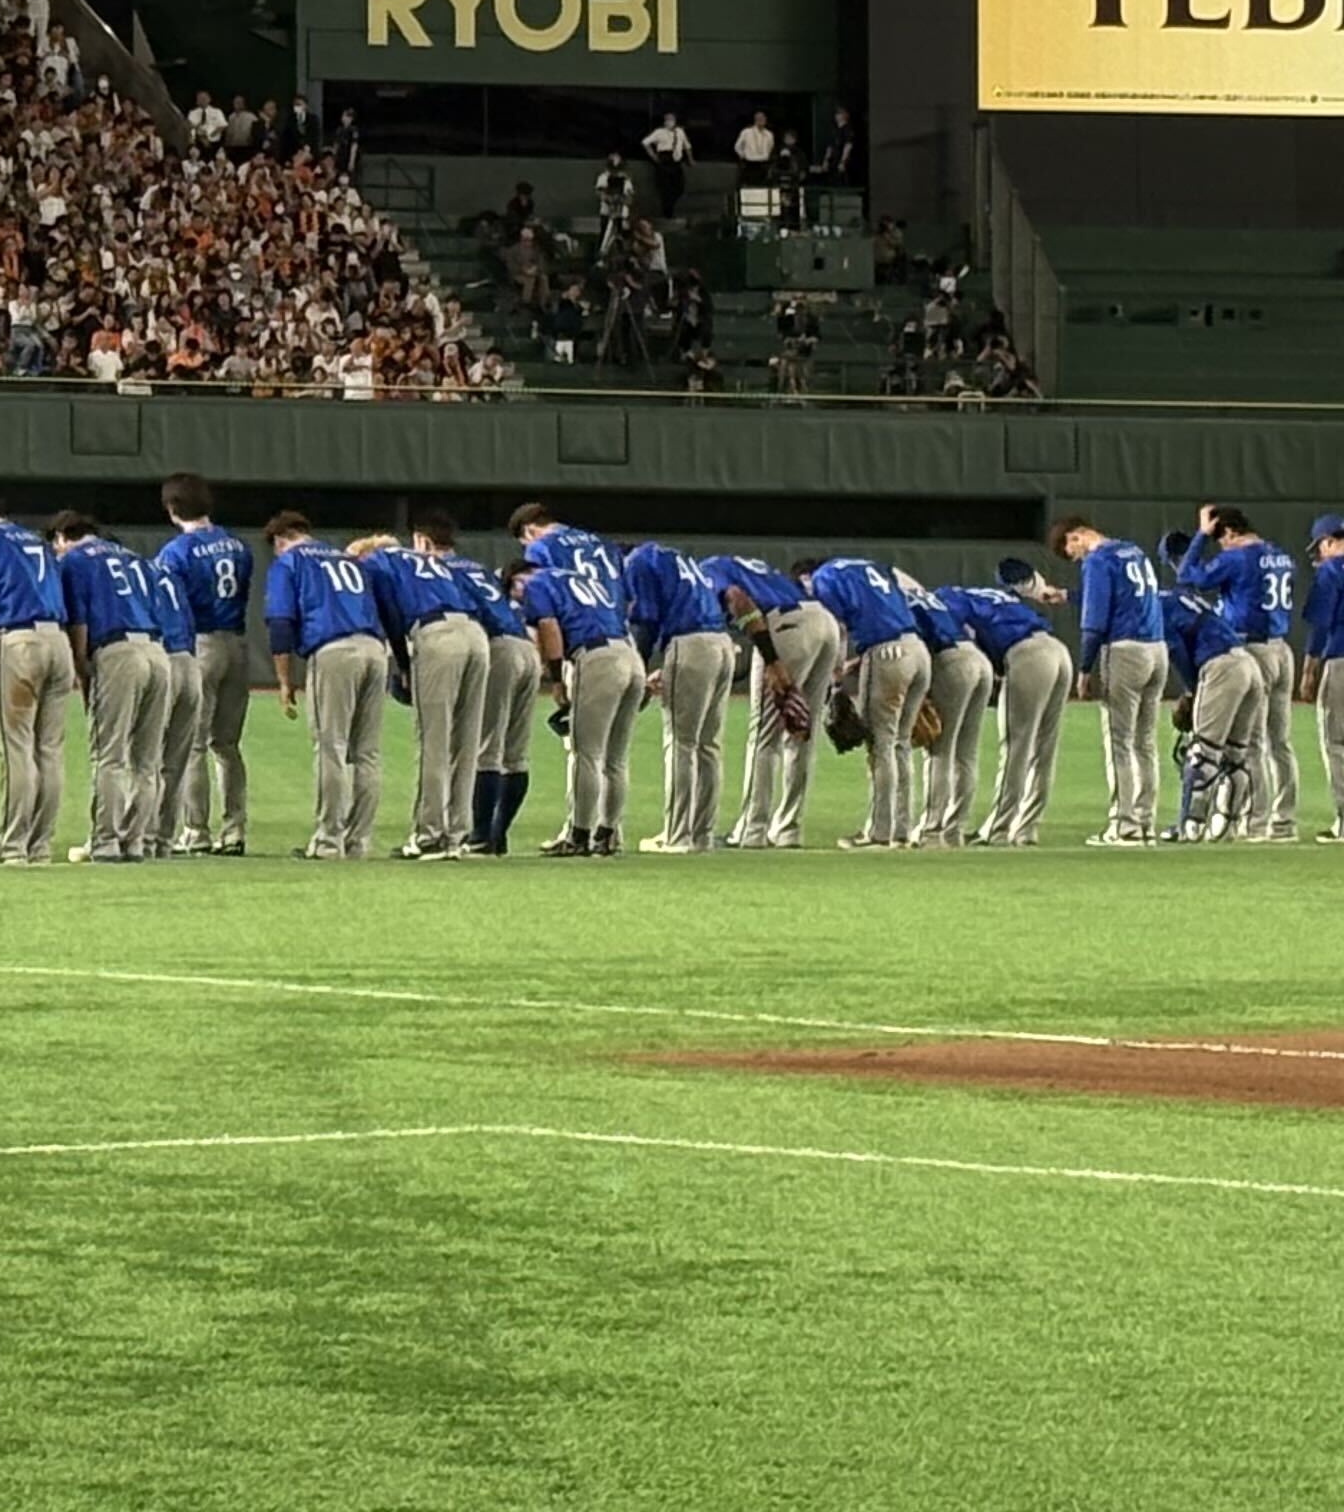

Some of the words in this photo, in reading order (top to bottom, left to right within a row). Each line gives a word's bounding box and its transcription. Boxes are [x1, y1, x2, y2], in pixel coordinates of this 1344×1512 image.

[22, 545, 44, 583] 7
[106, 558, 148, 597] 51
[215, 558, 238, 599] 8
[320, 559, 364, 594] 10
[865, 565, 890, 595] 4
[1261, 571, 1293, 610] 36
